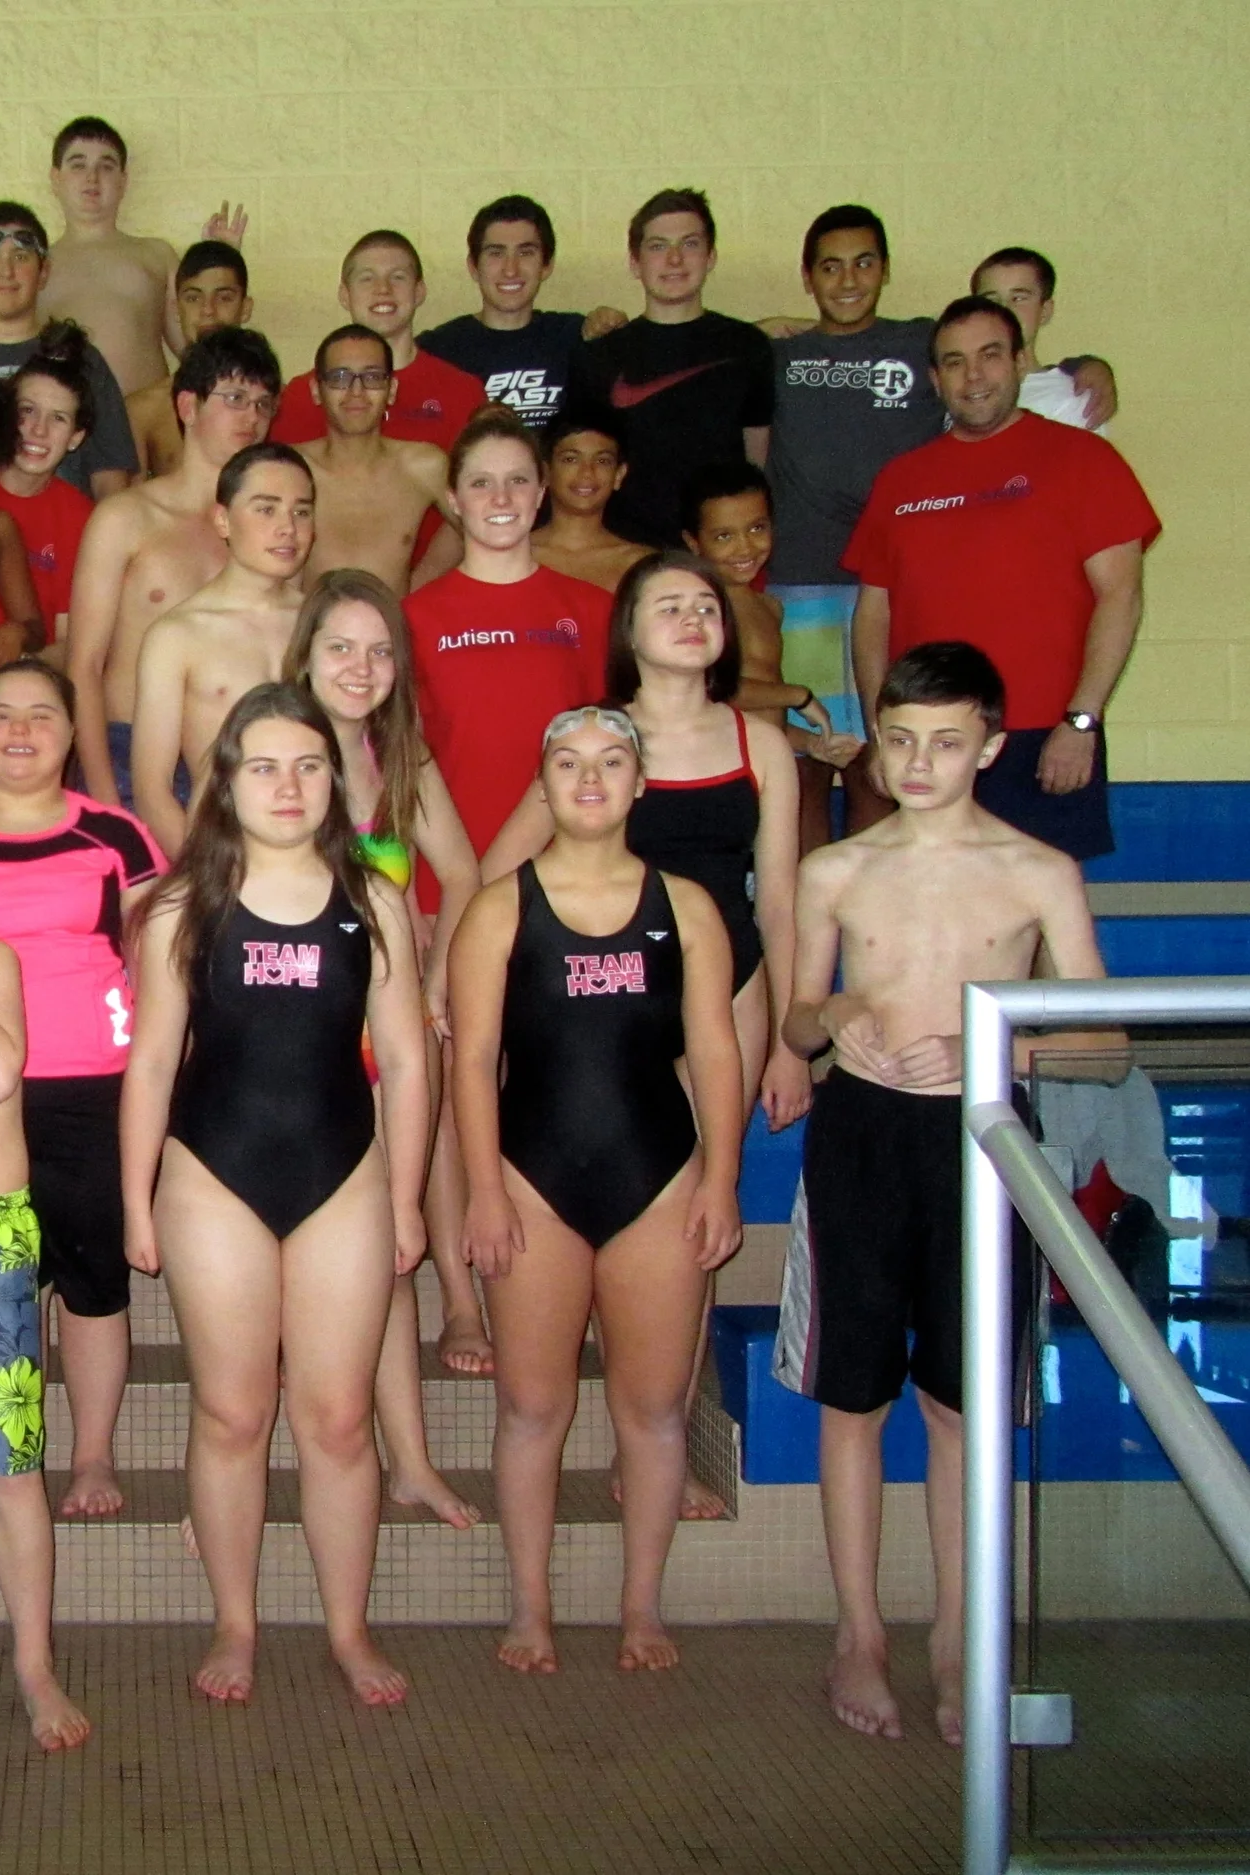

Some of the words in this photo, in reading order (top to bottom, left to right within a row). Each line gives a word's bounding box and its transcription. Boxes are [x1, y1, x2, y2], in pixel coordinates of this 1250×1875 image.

[835, 361, 871, 369] HILLS
[484, 369, 547, 392] BIG
[786, 366, 909, 389] SOCCER
[873, 399, 908, 409] 2014
[895, 495, 965, 516] autism
[438, 629, 515, 652] autism
[243, 942, 320, 967] TEAM
[564, 951, 644, 976] TEAM
[243, 962, 318, 987] HOPE
[566, 971, 646, 997] HOPE
